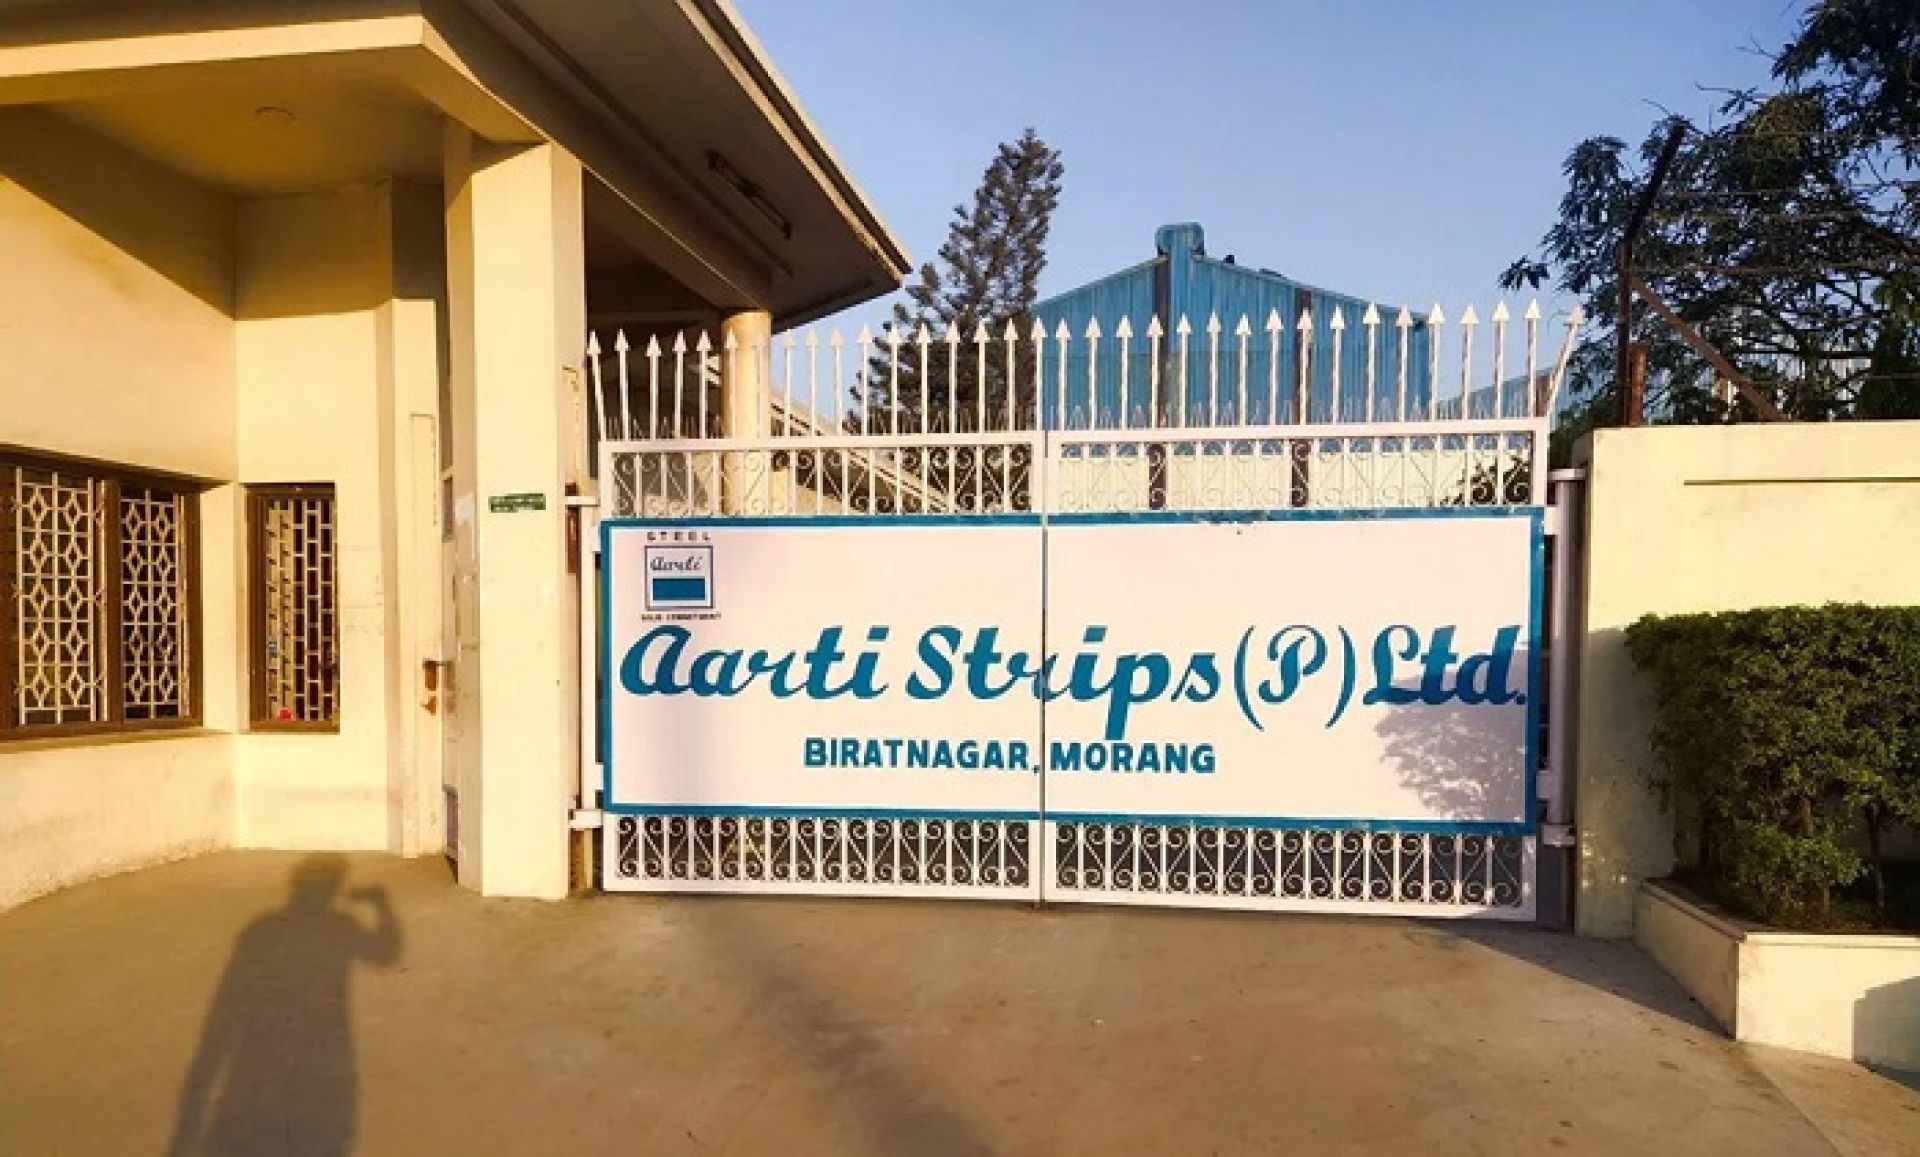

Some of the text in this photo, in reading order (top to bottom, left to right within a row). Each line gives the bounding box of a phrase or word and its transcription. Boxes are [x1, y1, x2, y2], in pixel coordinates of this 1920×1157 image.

[619, 624, 890, 700] Aarti
[905, 624, 1219, 740] Strips
[1363, 624, 1526, 706] Ltd.
[803, 737, 1215, 774] BIRATNAGAR, MORANG
